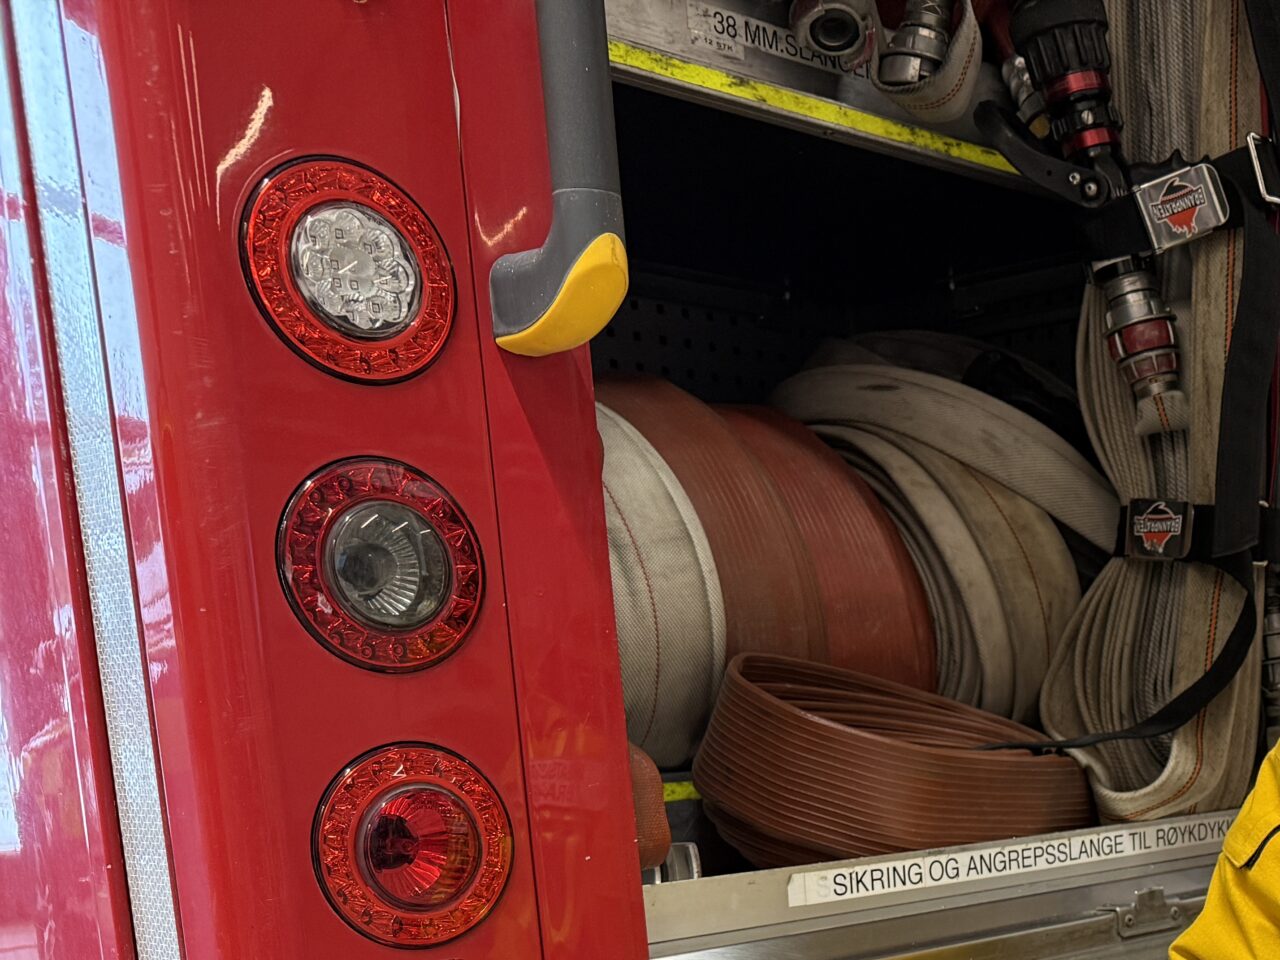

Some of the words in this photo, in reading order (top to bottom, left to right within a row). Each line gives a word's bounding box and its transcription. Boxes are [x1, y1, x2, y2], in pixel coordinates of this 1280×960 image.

[713, 11, 738, 39] 38
[833, 862, 923, 897] SIKRING
[929, 857, 960, 882] OG
[965, 834, 1125, 878] ANGREPSSLANGE
[1129, 831, 1152, 851] TIL
